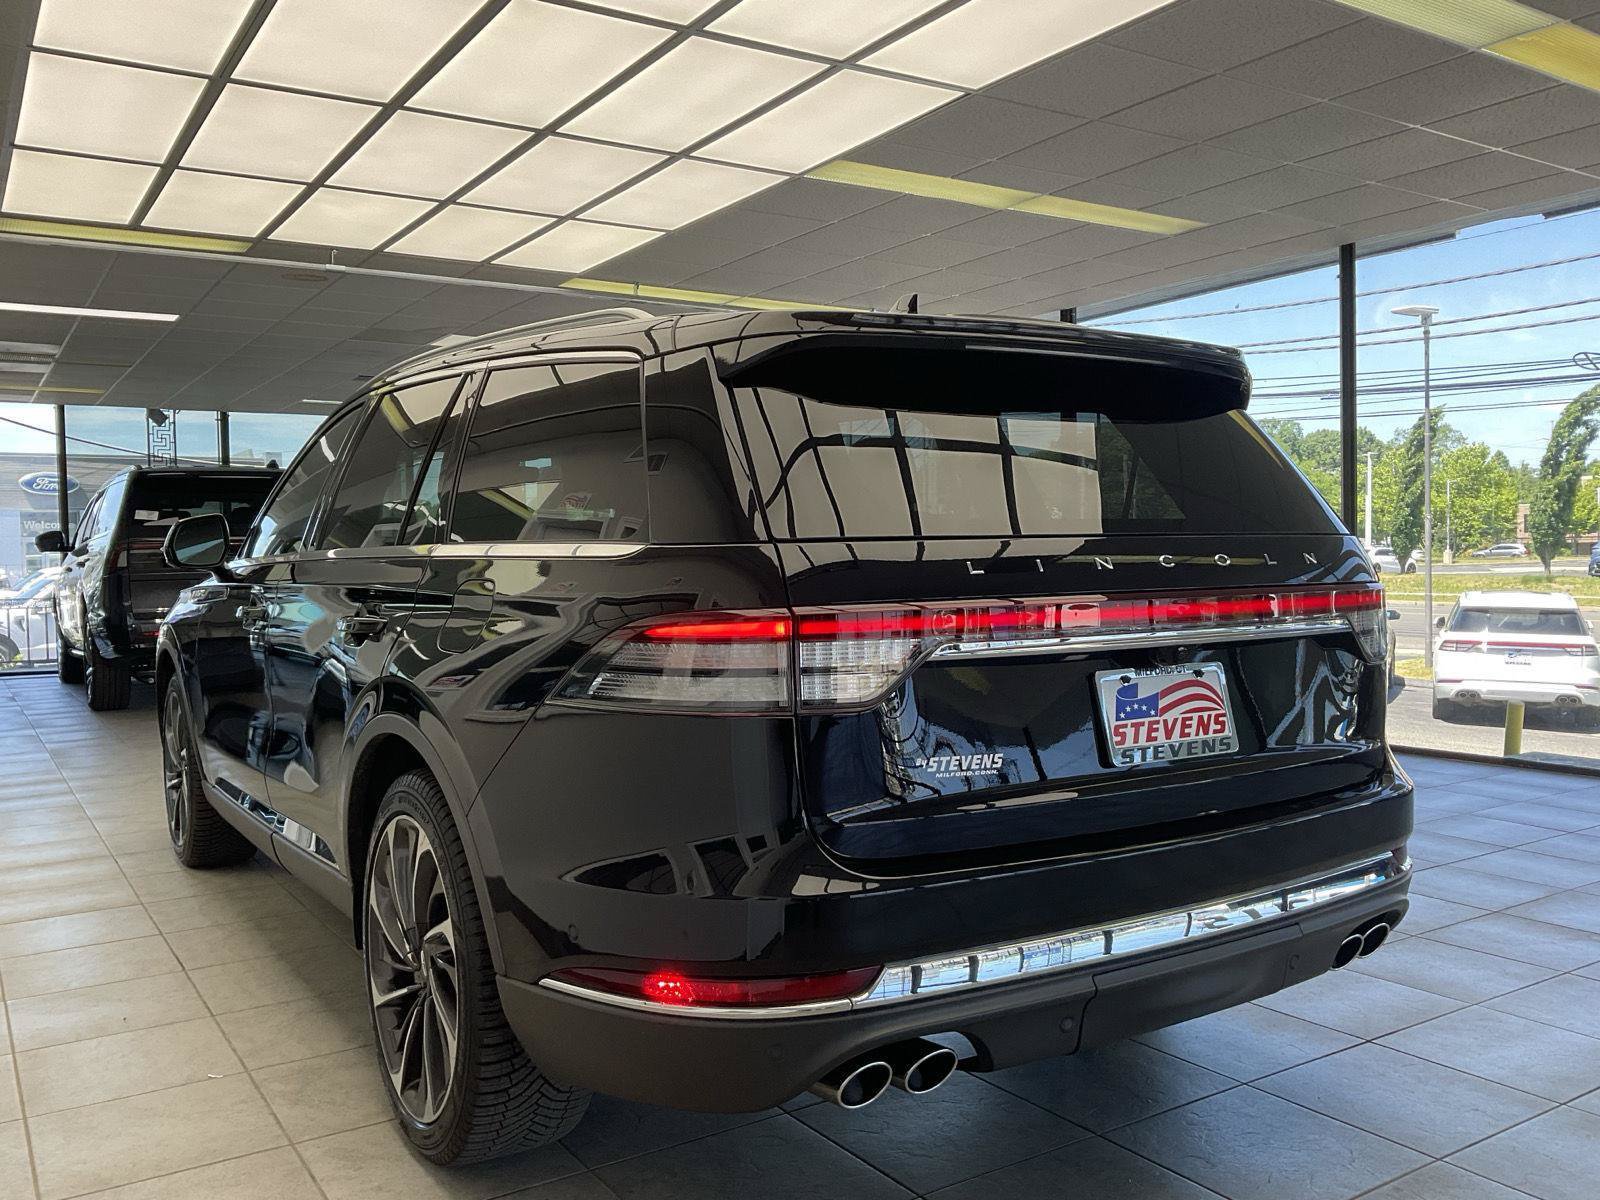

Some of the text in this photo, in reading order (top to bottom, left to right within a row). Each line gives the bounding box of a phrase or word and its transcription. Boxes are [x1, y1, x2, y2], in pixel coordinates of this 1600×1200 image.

[32, 477, 60, 490] For
[966, 552, 1318, 576] LINCOLN
[1113, 712, 1227, 747] STEVENS
[927, 753, 1004, 772] STEVENS
[1120, 736, 1232, 765] STEVENS
